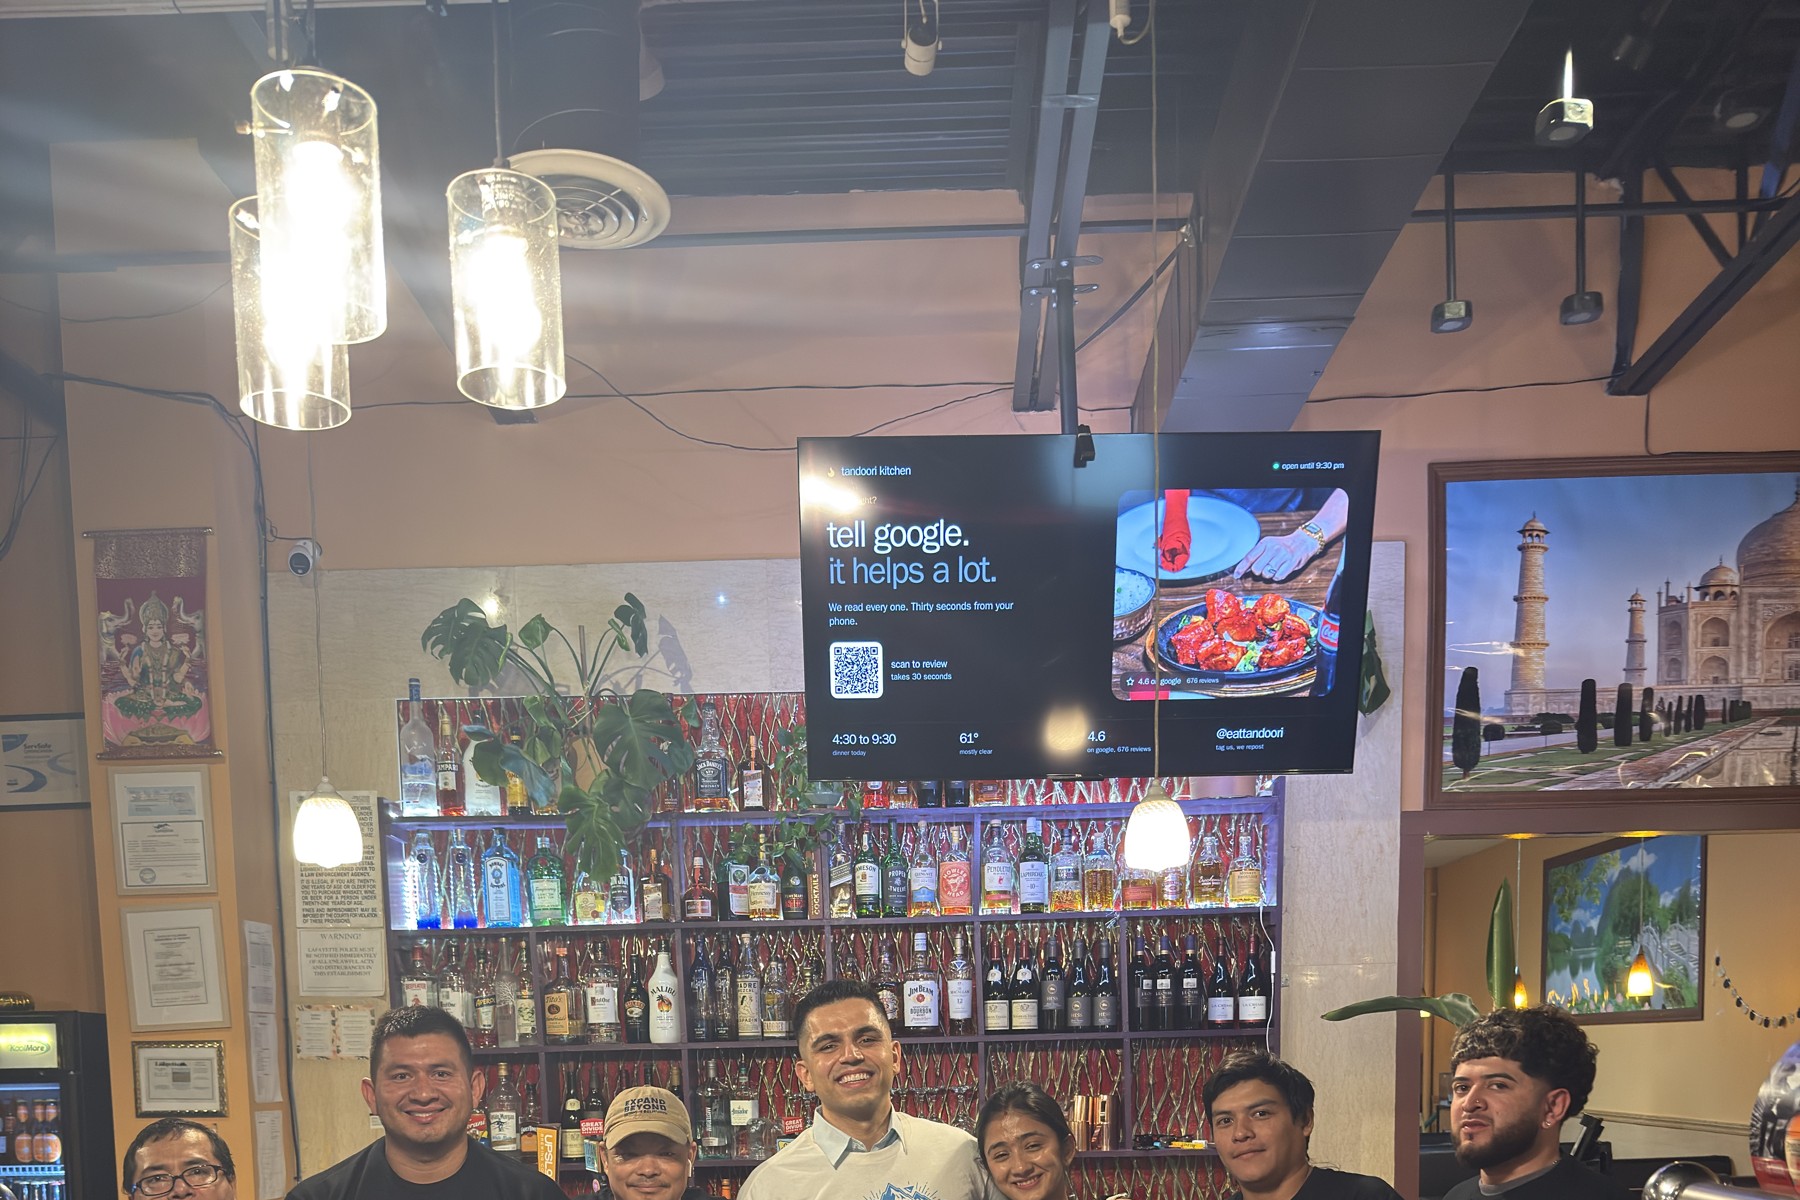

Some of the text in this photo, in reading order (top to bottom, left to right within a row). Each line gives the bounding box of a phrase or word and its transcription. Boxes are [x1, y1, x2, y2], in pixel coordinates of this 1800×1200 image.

[841, 465, 911, 476] tandoori kitchen
[1282, 462, 1344, 470] open until 9:30 pm
[826, 518, 969, 555] tell google.
[829, 555, 997, 590] it helps a lot.
[828, 601, 1014, 614] We read every one. Thirty seconds from your
[829, 617, 858, 628] phone.
[890, 660, 948, 669] scan to review
[890, 672, 952, 681] takes 30 seconds
[1137, 677, 1150, 686] 4.6
[1160, 677, 1182, 687] google
[1186, 676, 1198, 684] 676
[1199, 676, 1220, 684] reviews
[959, 732, 979, 744] 61°
[1087, 730, 1106, 742] 4.6
[1216, 726, 1285, 740] @eattandoori
[832, 733, 897, 745] 4:30 to 9:30
[959, 748, 993, 756] mostly clear
[1116, 746, 1130, 754] 676
[1216, 744, 1226, 752] tag
[1226, 744, 1235, 752] us,
[1246, 743, 1265, 752] repost
[850, 750, 867, 758] today
[437, 763, 458, 772] AMPARI
[943, 868, 968, 880] HOWLER
[946, 890, 964, 898] HEAD
[650, 986, 676, 996] MALIBU
[908, 984, 934, 997] JIM BEAM
[625, 1097, 666, 1107] EXPAND
[624, 1103, 667, 1112] BEYOND
[467, 1121, 485, 1129] orani
